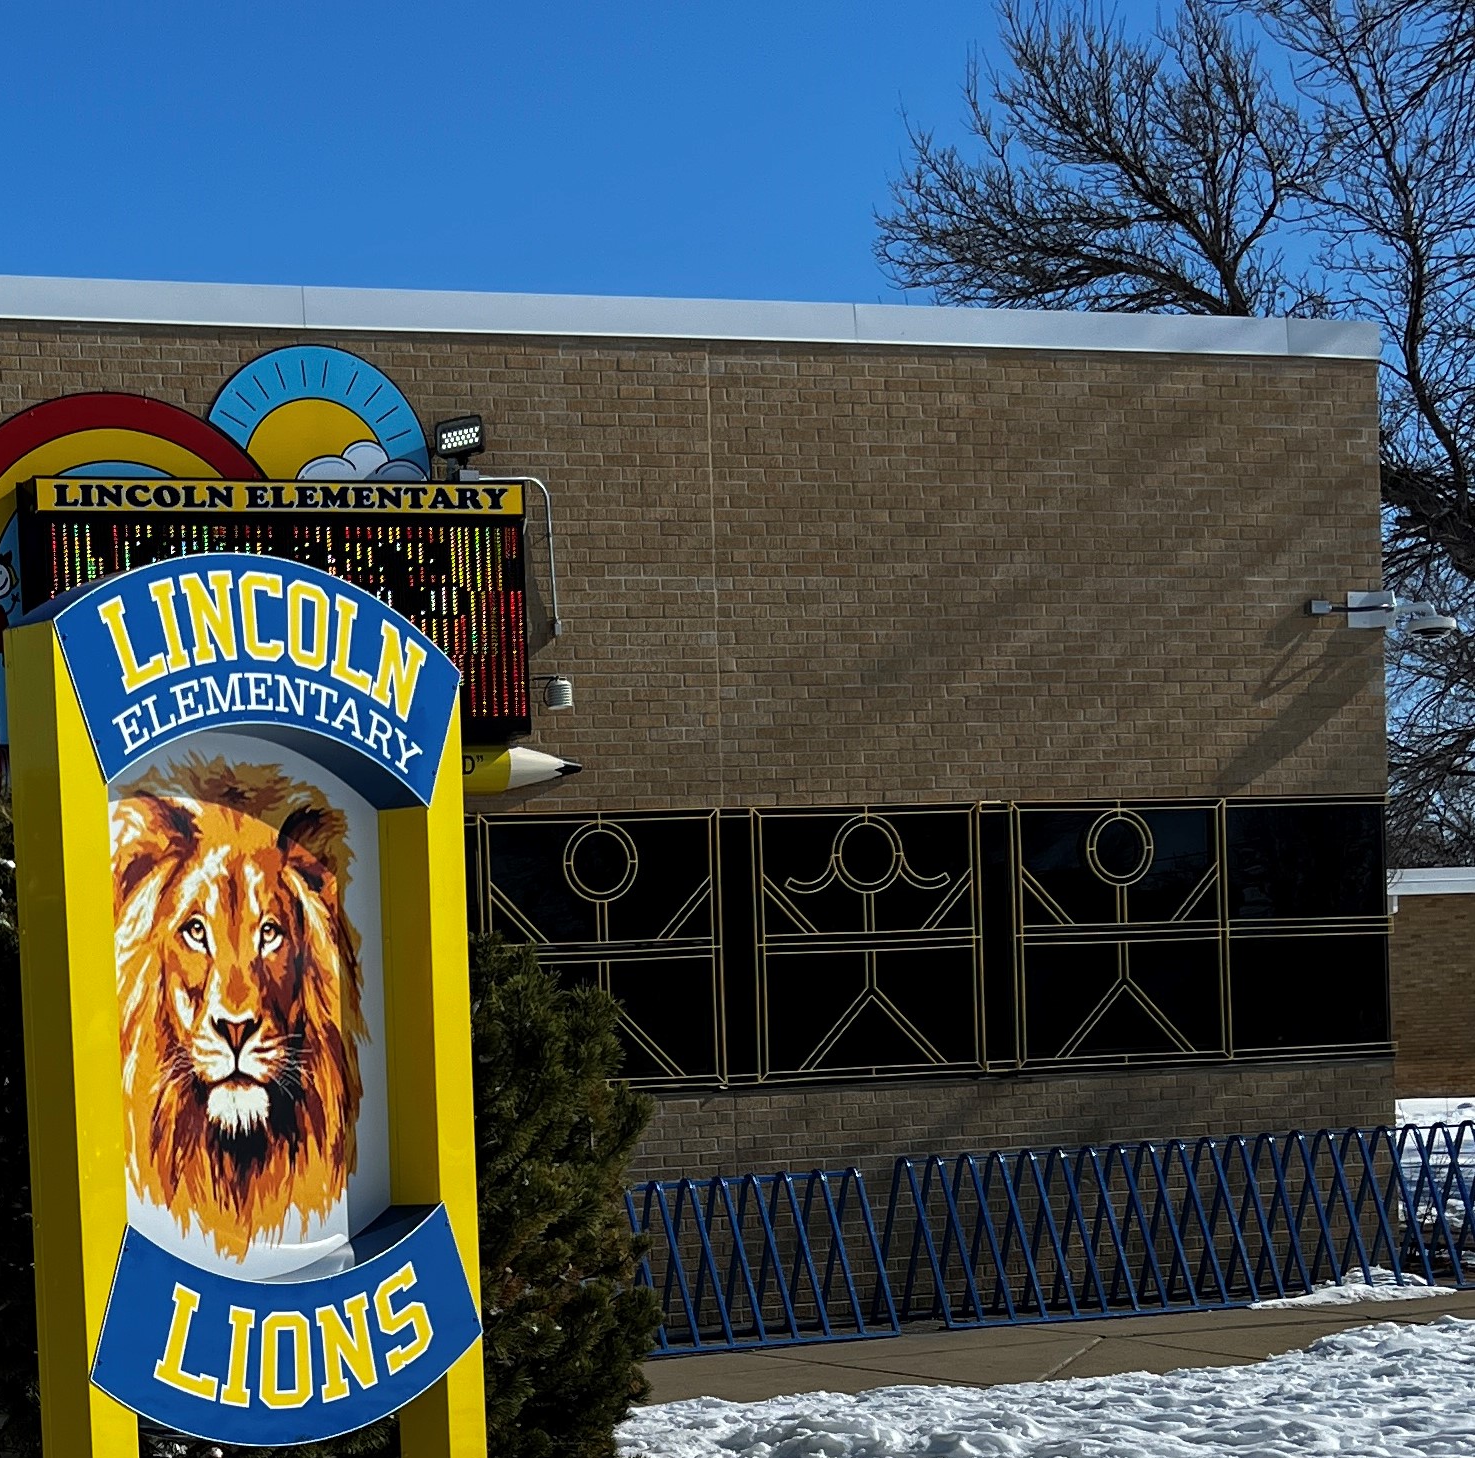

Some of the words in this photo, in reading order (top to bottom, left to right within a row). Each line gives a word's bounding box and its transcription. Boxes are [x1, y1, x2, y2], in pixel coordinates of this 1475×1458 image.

[53, 483, 235, 509] LINCOLN
[244, 485, 509, 511] ELEMENTARY
[97, 570, 428, 722] LINCOLN
[112, 672, 423, 774] ELEMENTARY
[153, 1261, 434, 1409] LIONS
